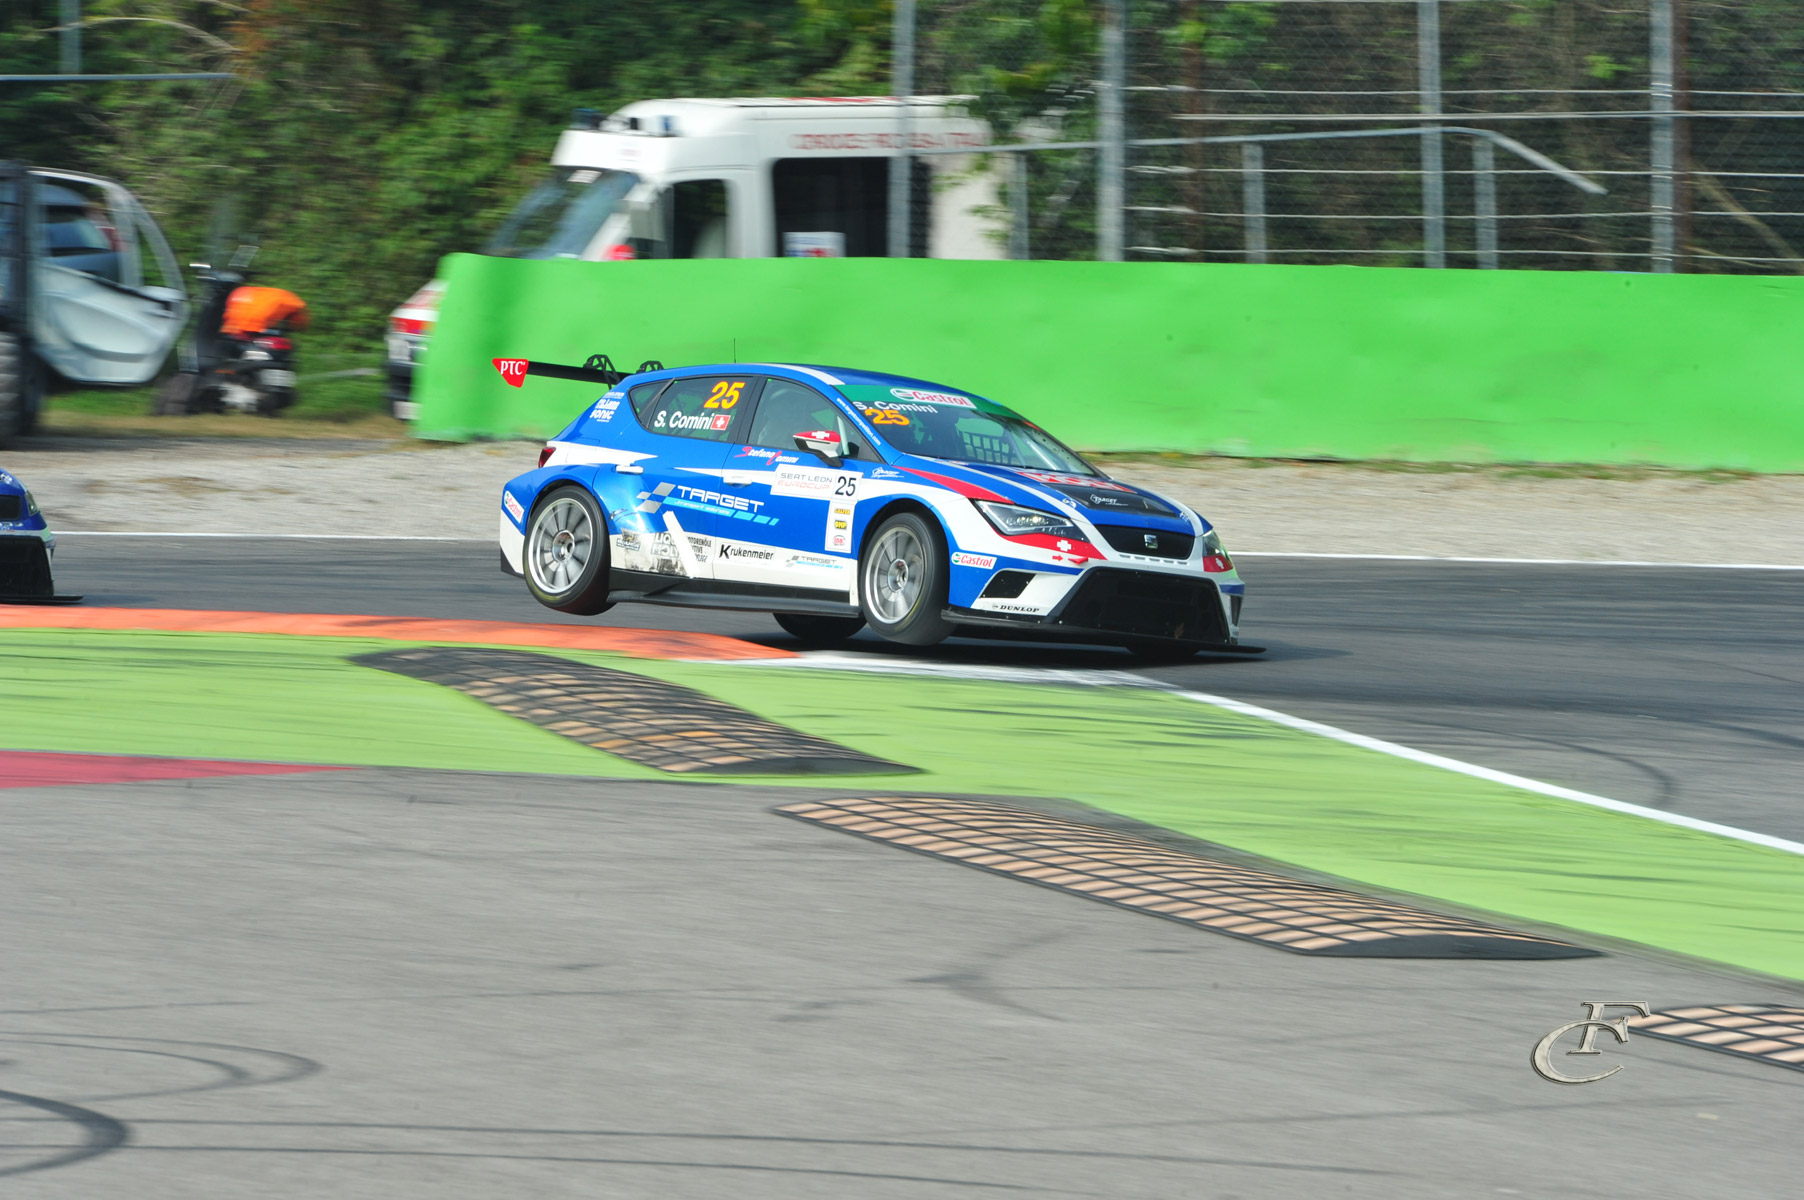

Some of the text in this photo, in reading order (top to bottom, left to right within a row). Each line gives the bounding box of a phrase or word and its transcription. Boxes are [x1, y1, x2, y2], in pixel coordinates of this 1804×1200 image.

[500, 360, 523, 375] PTC
[703, 381, 745, 409] 25
[912, 391, 969, 406] Castrol
[852, 401, 938, 414] S. Comini
[654, 410, 715, 430] S. Comini
[864, 408, 910, 426] 25
[777, 480, 830, 489] EUROCUP
[780, 472, 833, 483] SEAT LEON
[835, 476, 857, 496] 25
[677, 485, 765, 513] TARGET
[719, 544, 774, 560] Krukenmeier
[961, 555, 993, 567] Castrol
[999, 604, 1040, 613] DUNLOP
